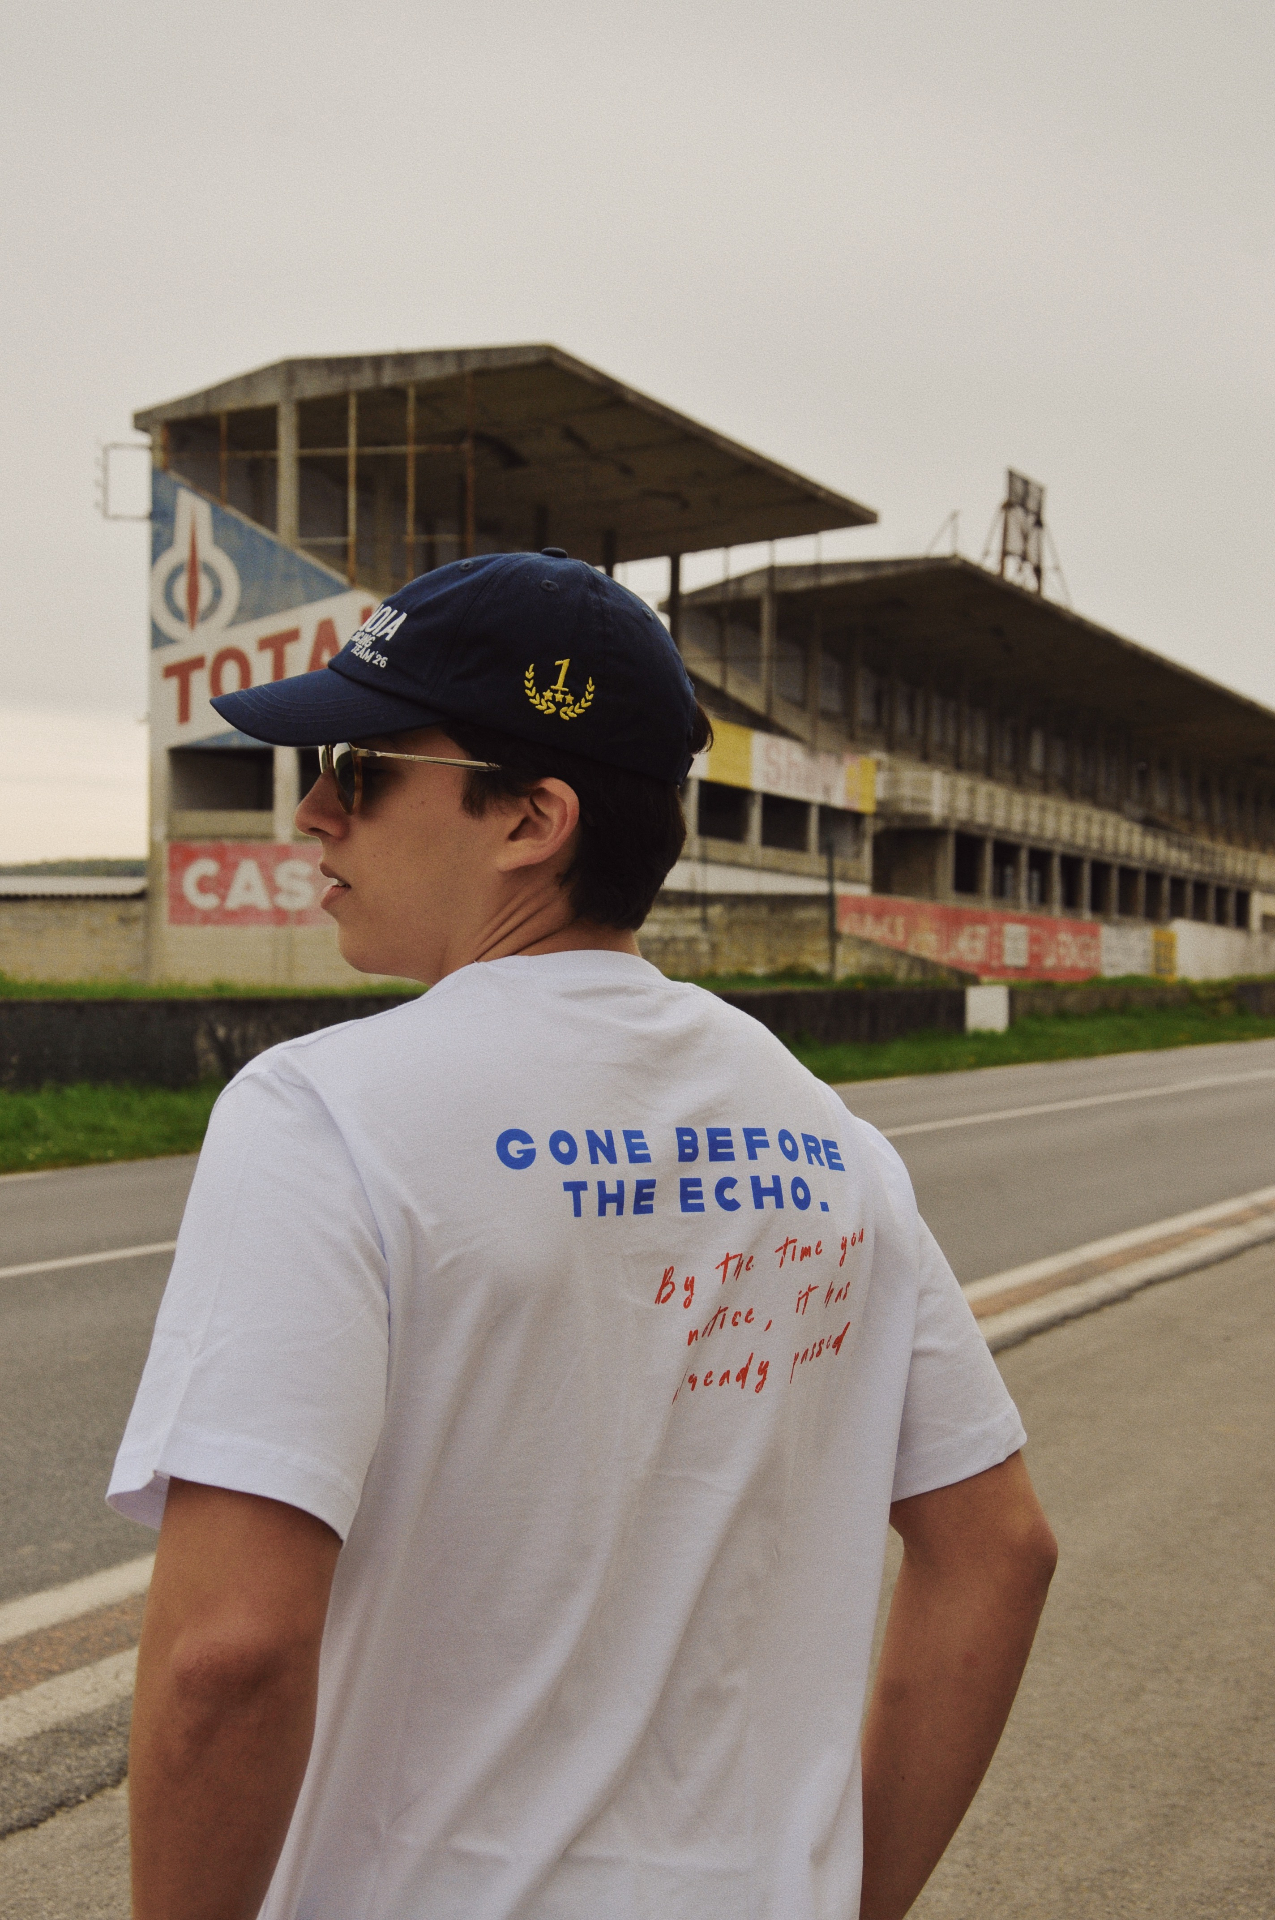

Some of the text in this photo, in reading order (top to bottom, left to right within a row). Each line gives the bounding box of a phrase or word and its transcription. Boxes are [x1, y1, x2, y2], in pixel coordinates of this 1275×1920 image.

[163, 606, 375, 725] TOTA
[351, 642, 375, 662] TEAM
[550, 658, 570, 691] 1
[182, 858, 315, 911] CAS
[495, 1127, 846, 1172] GONE BEFORE
[562, 1174, 830, 1218] THE ECHO.
[655, 1227, 864, 1309] By the time you
[795, 1283, 819, 1316] it
[824, 1280, 851, 1309] has
[790, 1321, 851, 1385] passed
